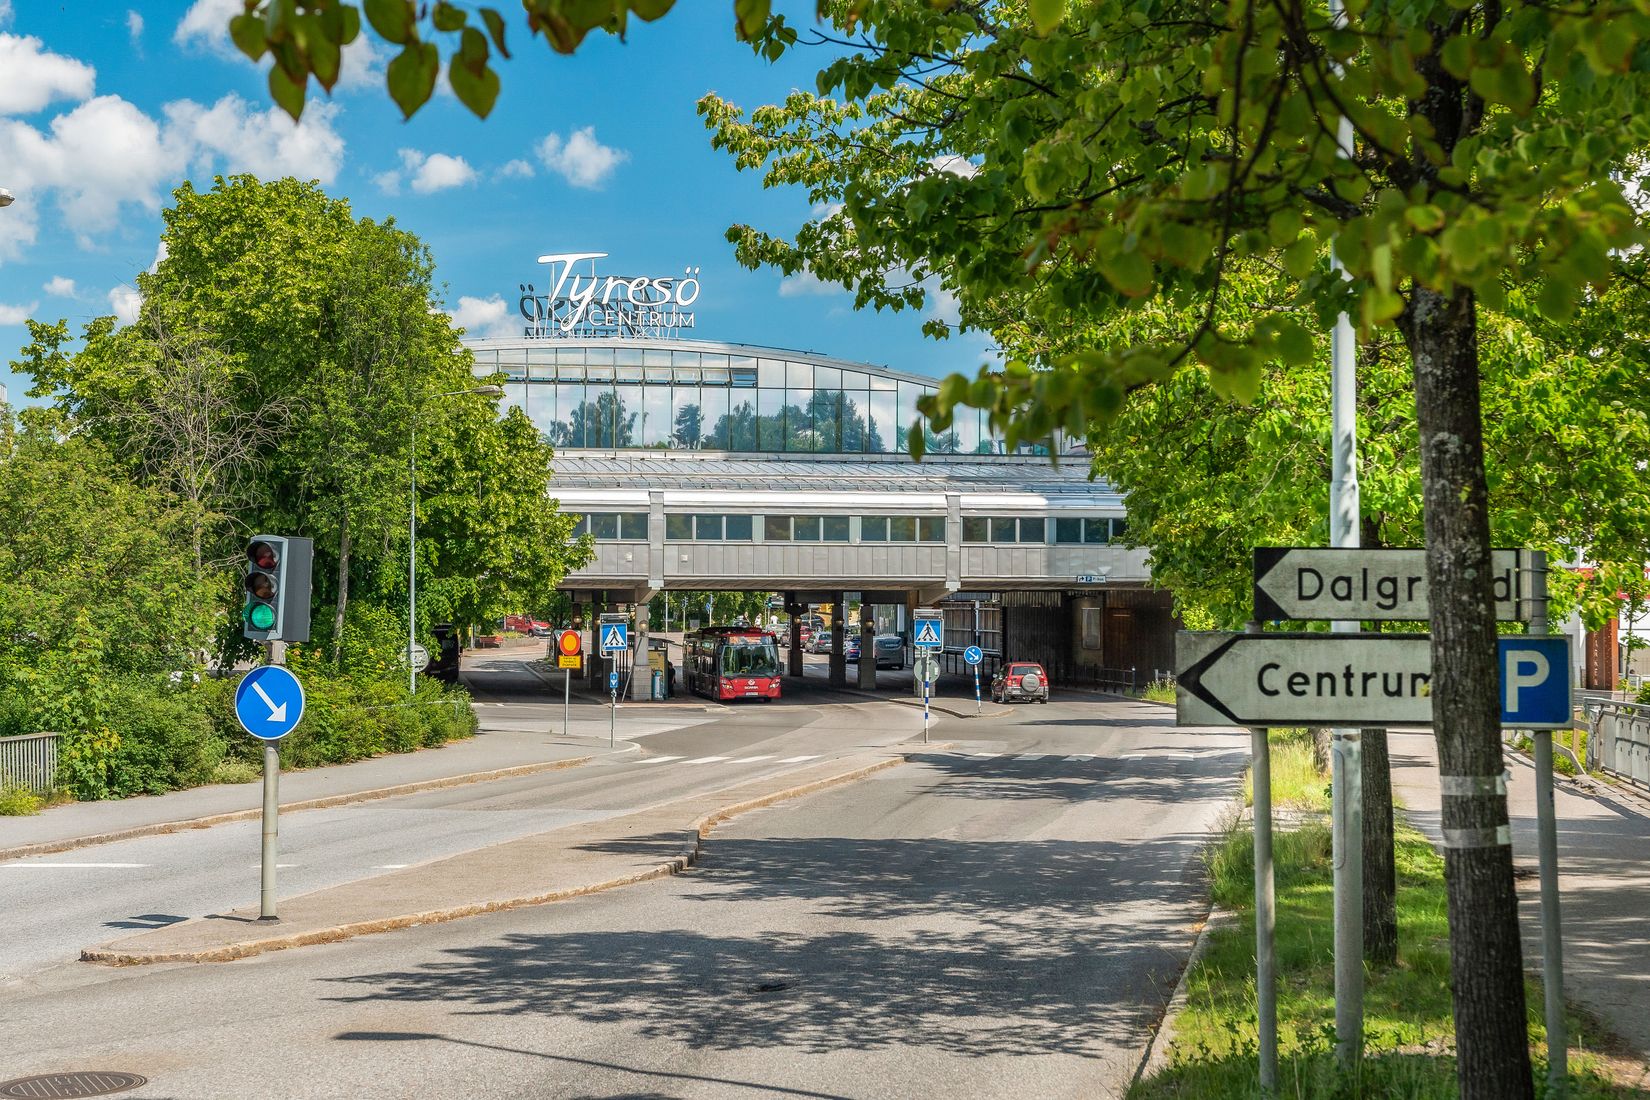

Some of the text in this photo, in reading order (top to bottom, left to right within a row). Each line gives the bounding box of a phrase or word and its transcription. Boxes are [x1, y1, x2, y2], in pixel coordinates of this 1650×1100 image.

[537, 252, 701, 332] Tyresö
[588, 310, 695, 328] CENTRUM
[1297, 567, 1511, 610] Dalgrd
[1505, 650, 1550, 713] P
